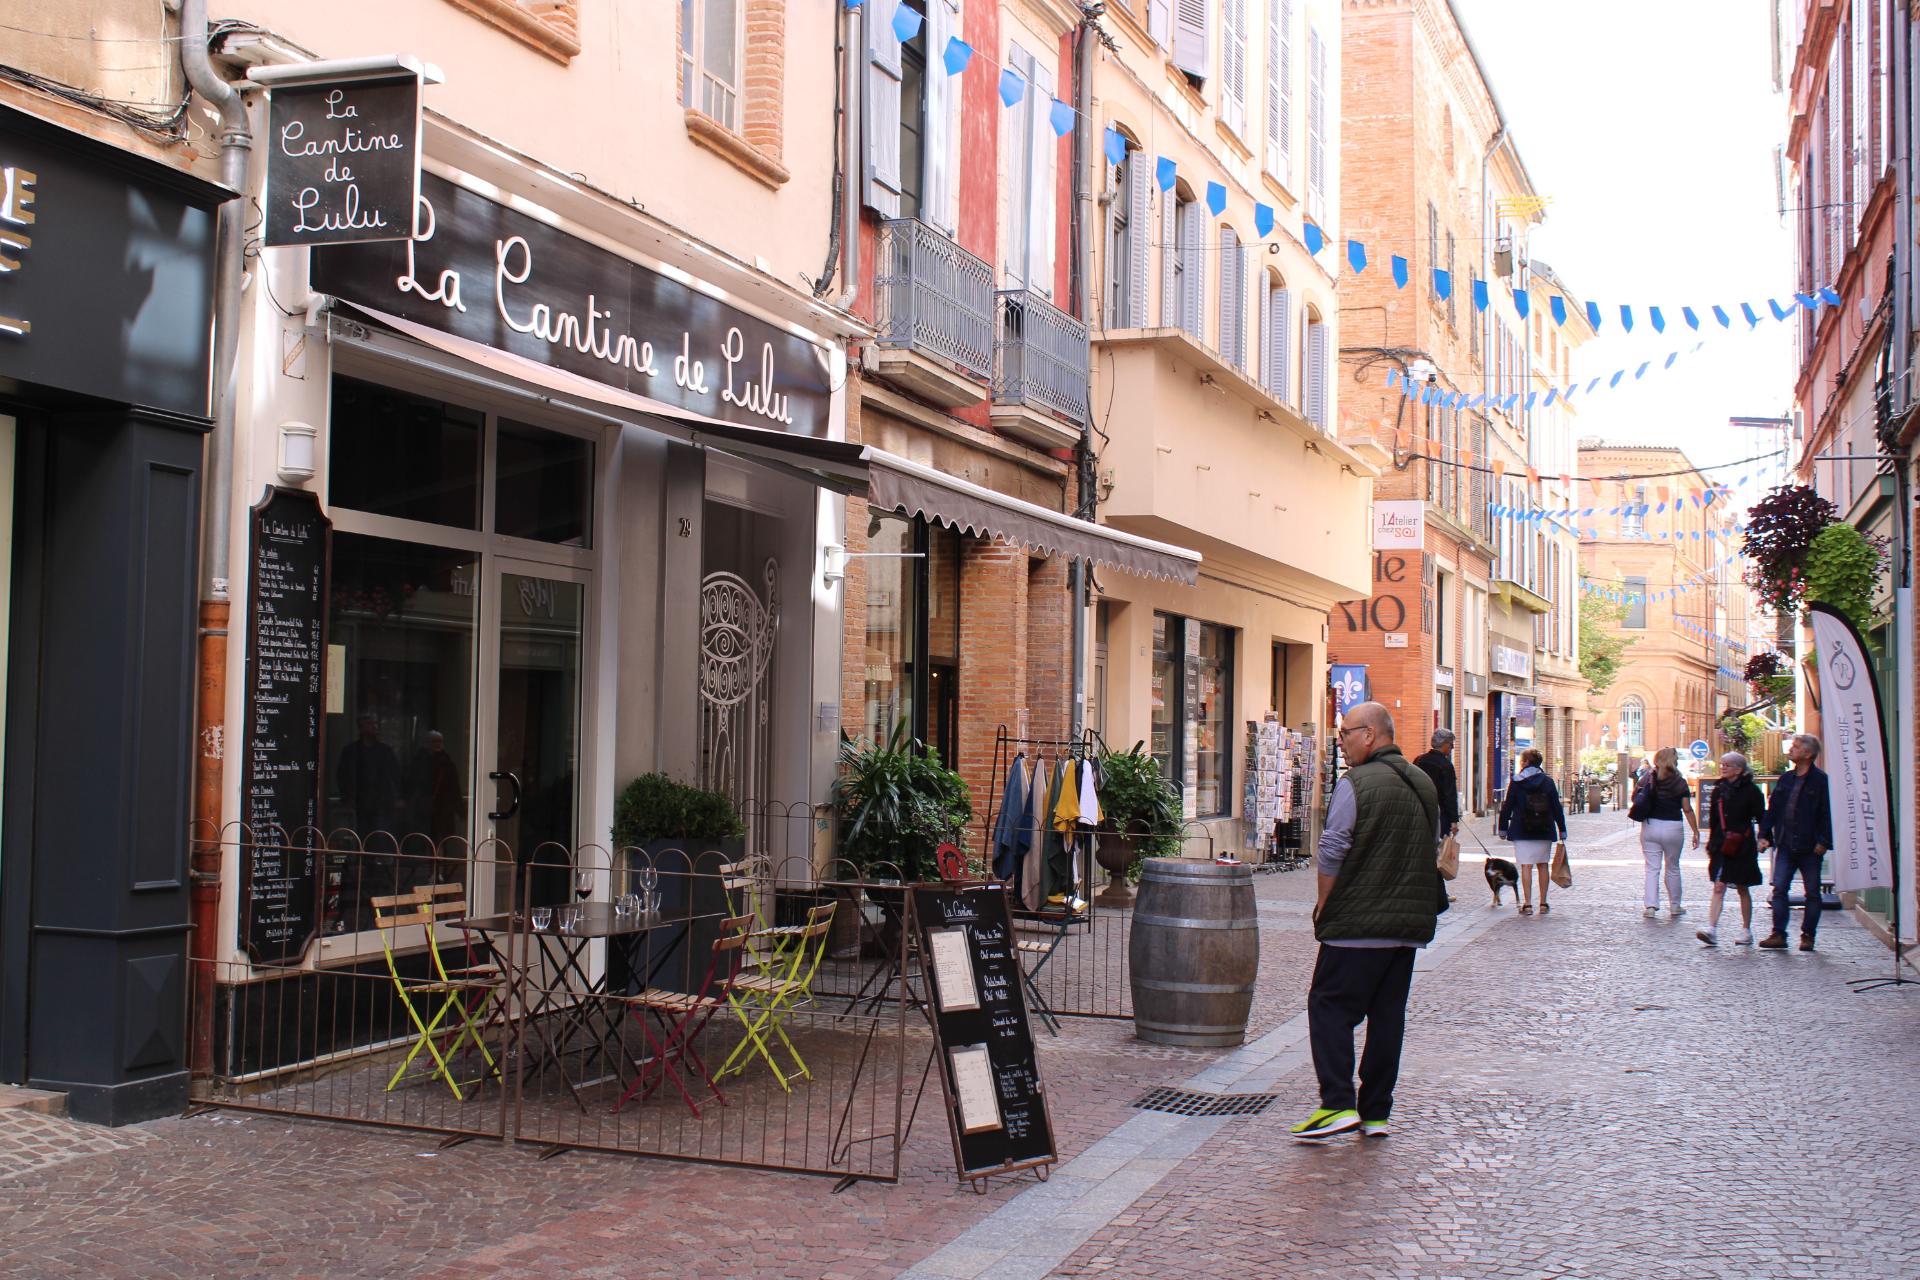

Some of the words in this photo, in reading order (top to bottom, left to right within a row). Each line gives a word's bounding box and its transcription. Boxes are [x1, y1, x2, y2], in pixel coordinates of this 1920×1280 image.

[325, 89, 359, 120] La
[281, 121, 404, 157] Cantine
[324, 156, 355, 183] de
[292, 184, 387, 233] Lulu
[397, 195, 467, 313] La
[495, 236, 659, 377] Cantine
[674, 332, 709, 395] de
[720, 327, 793, 425] Lulu
